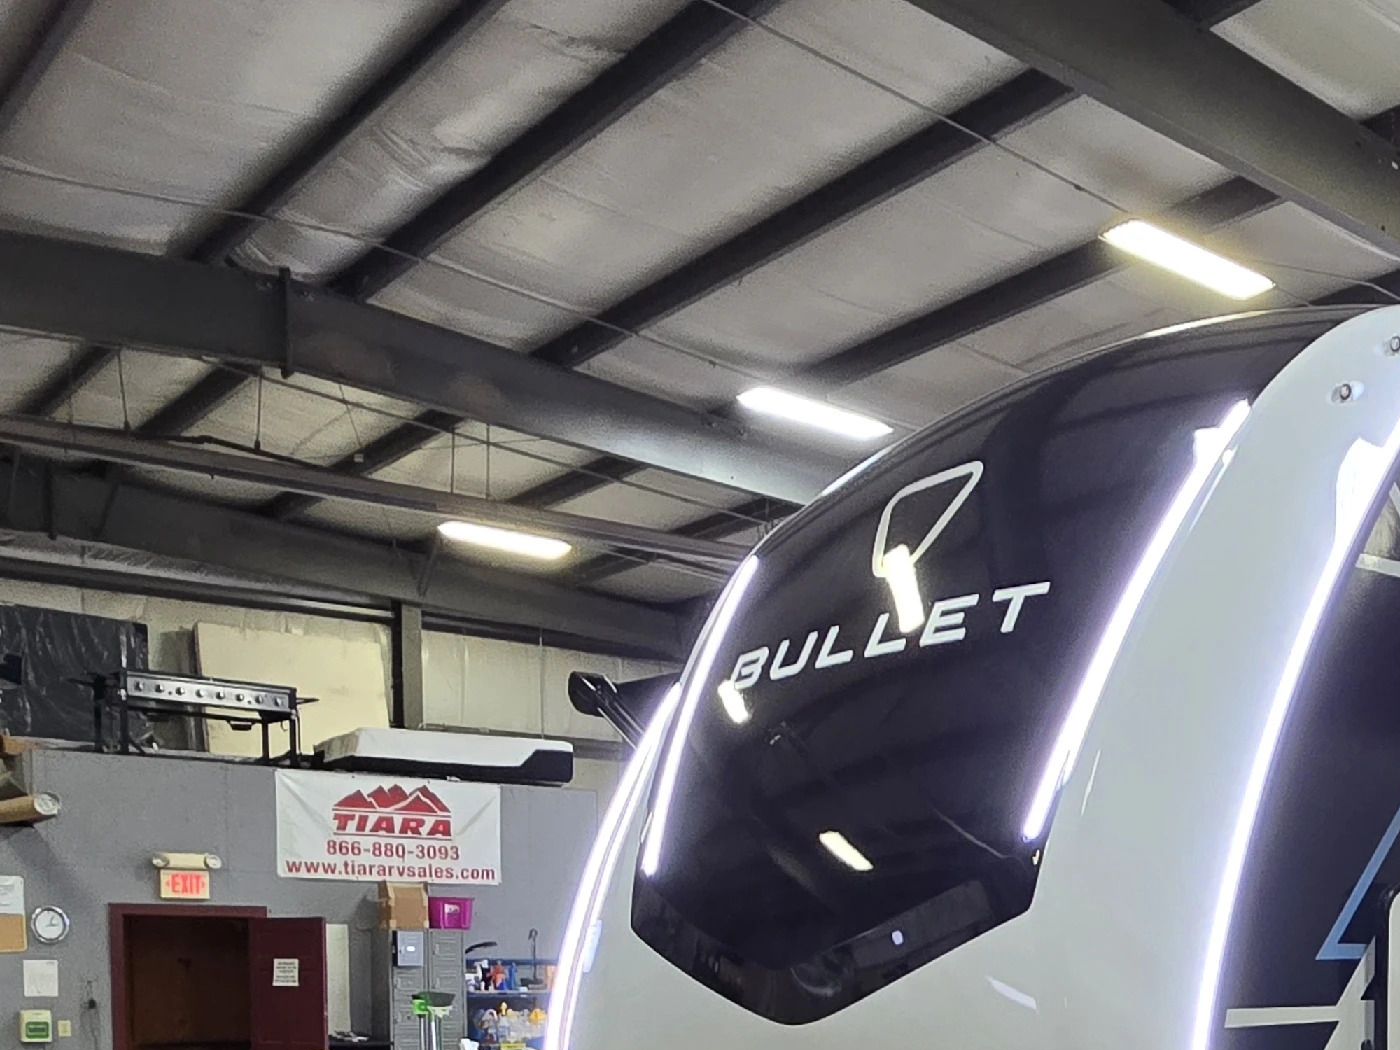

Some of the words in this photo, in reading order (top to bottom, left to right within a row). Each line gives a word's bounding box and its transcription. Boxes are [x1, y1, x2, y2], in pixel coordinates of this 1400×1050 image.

[733, 580, 1051, 690] BULLET
[332, 812, 452, 837] TIARA
[326, 839, 460, 861] 866-880-3093
[285, 859, 496, 881] www.tiararvsales.com
[171, 873, 202, 895] EXIT
